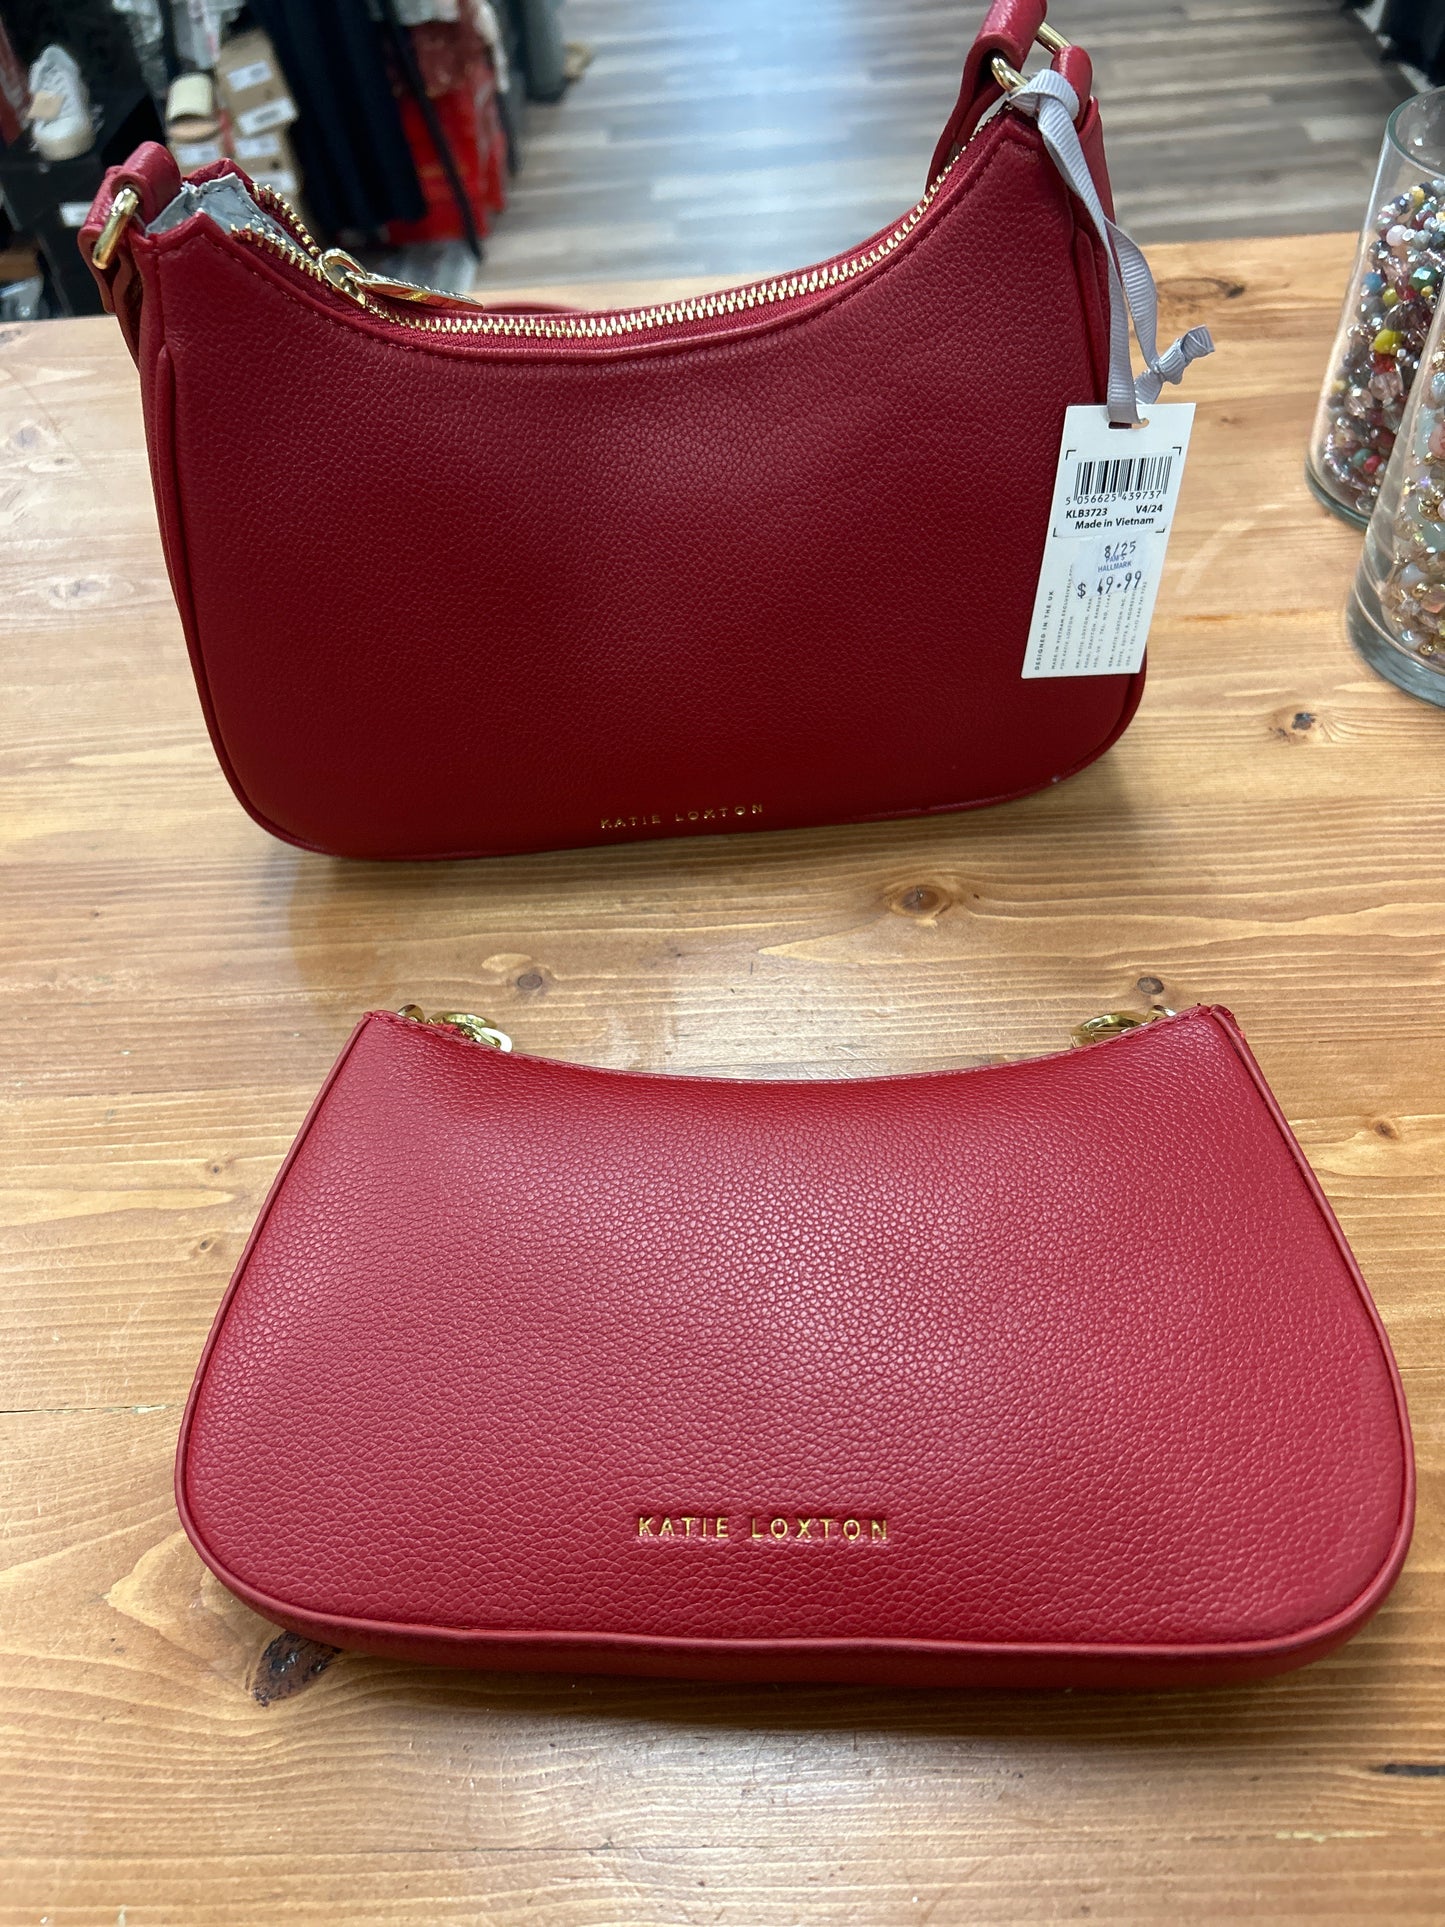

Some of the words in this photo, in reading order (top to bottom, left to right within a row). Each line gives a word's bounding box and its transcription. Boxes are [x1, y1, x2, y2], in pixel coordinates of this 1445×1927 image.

[1065, 496, 1071, 505] 5
[1077, 493, 1118, 504] 056625
[1122, 490, 1162, 501] 439737
[1065, 508, 1108, 519] KLB3723
[1136, 504, 1163, 514] V4/24
[1075, 519, 1101, 530] Made
[1103, 519, 1113, 528] in
[1115, 517, 1154, 527] Vietnam
[1104, 540, 1136, 559] 8/25
[1097, 561, 1132, 573] HALLMARK
[1034, 633, 1046, 670] DESIGNED
[1041, 622, 1048, 631] IN
[1048, 590, 1054, 601] UK
[600, 815, 661, 829] KATIE
[674, 804, 763, 822] LOXTON
[638, 1517, 729, 1538] KATIE
[752, 1518, 888, 1540] LOXTON
